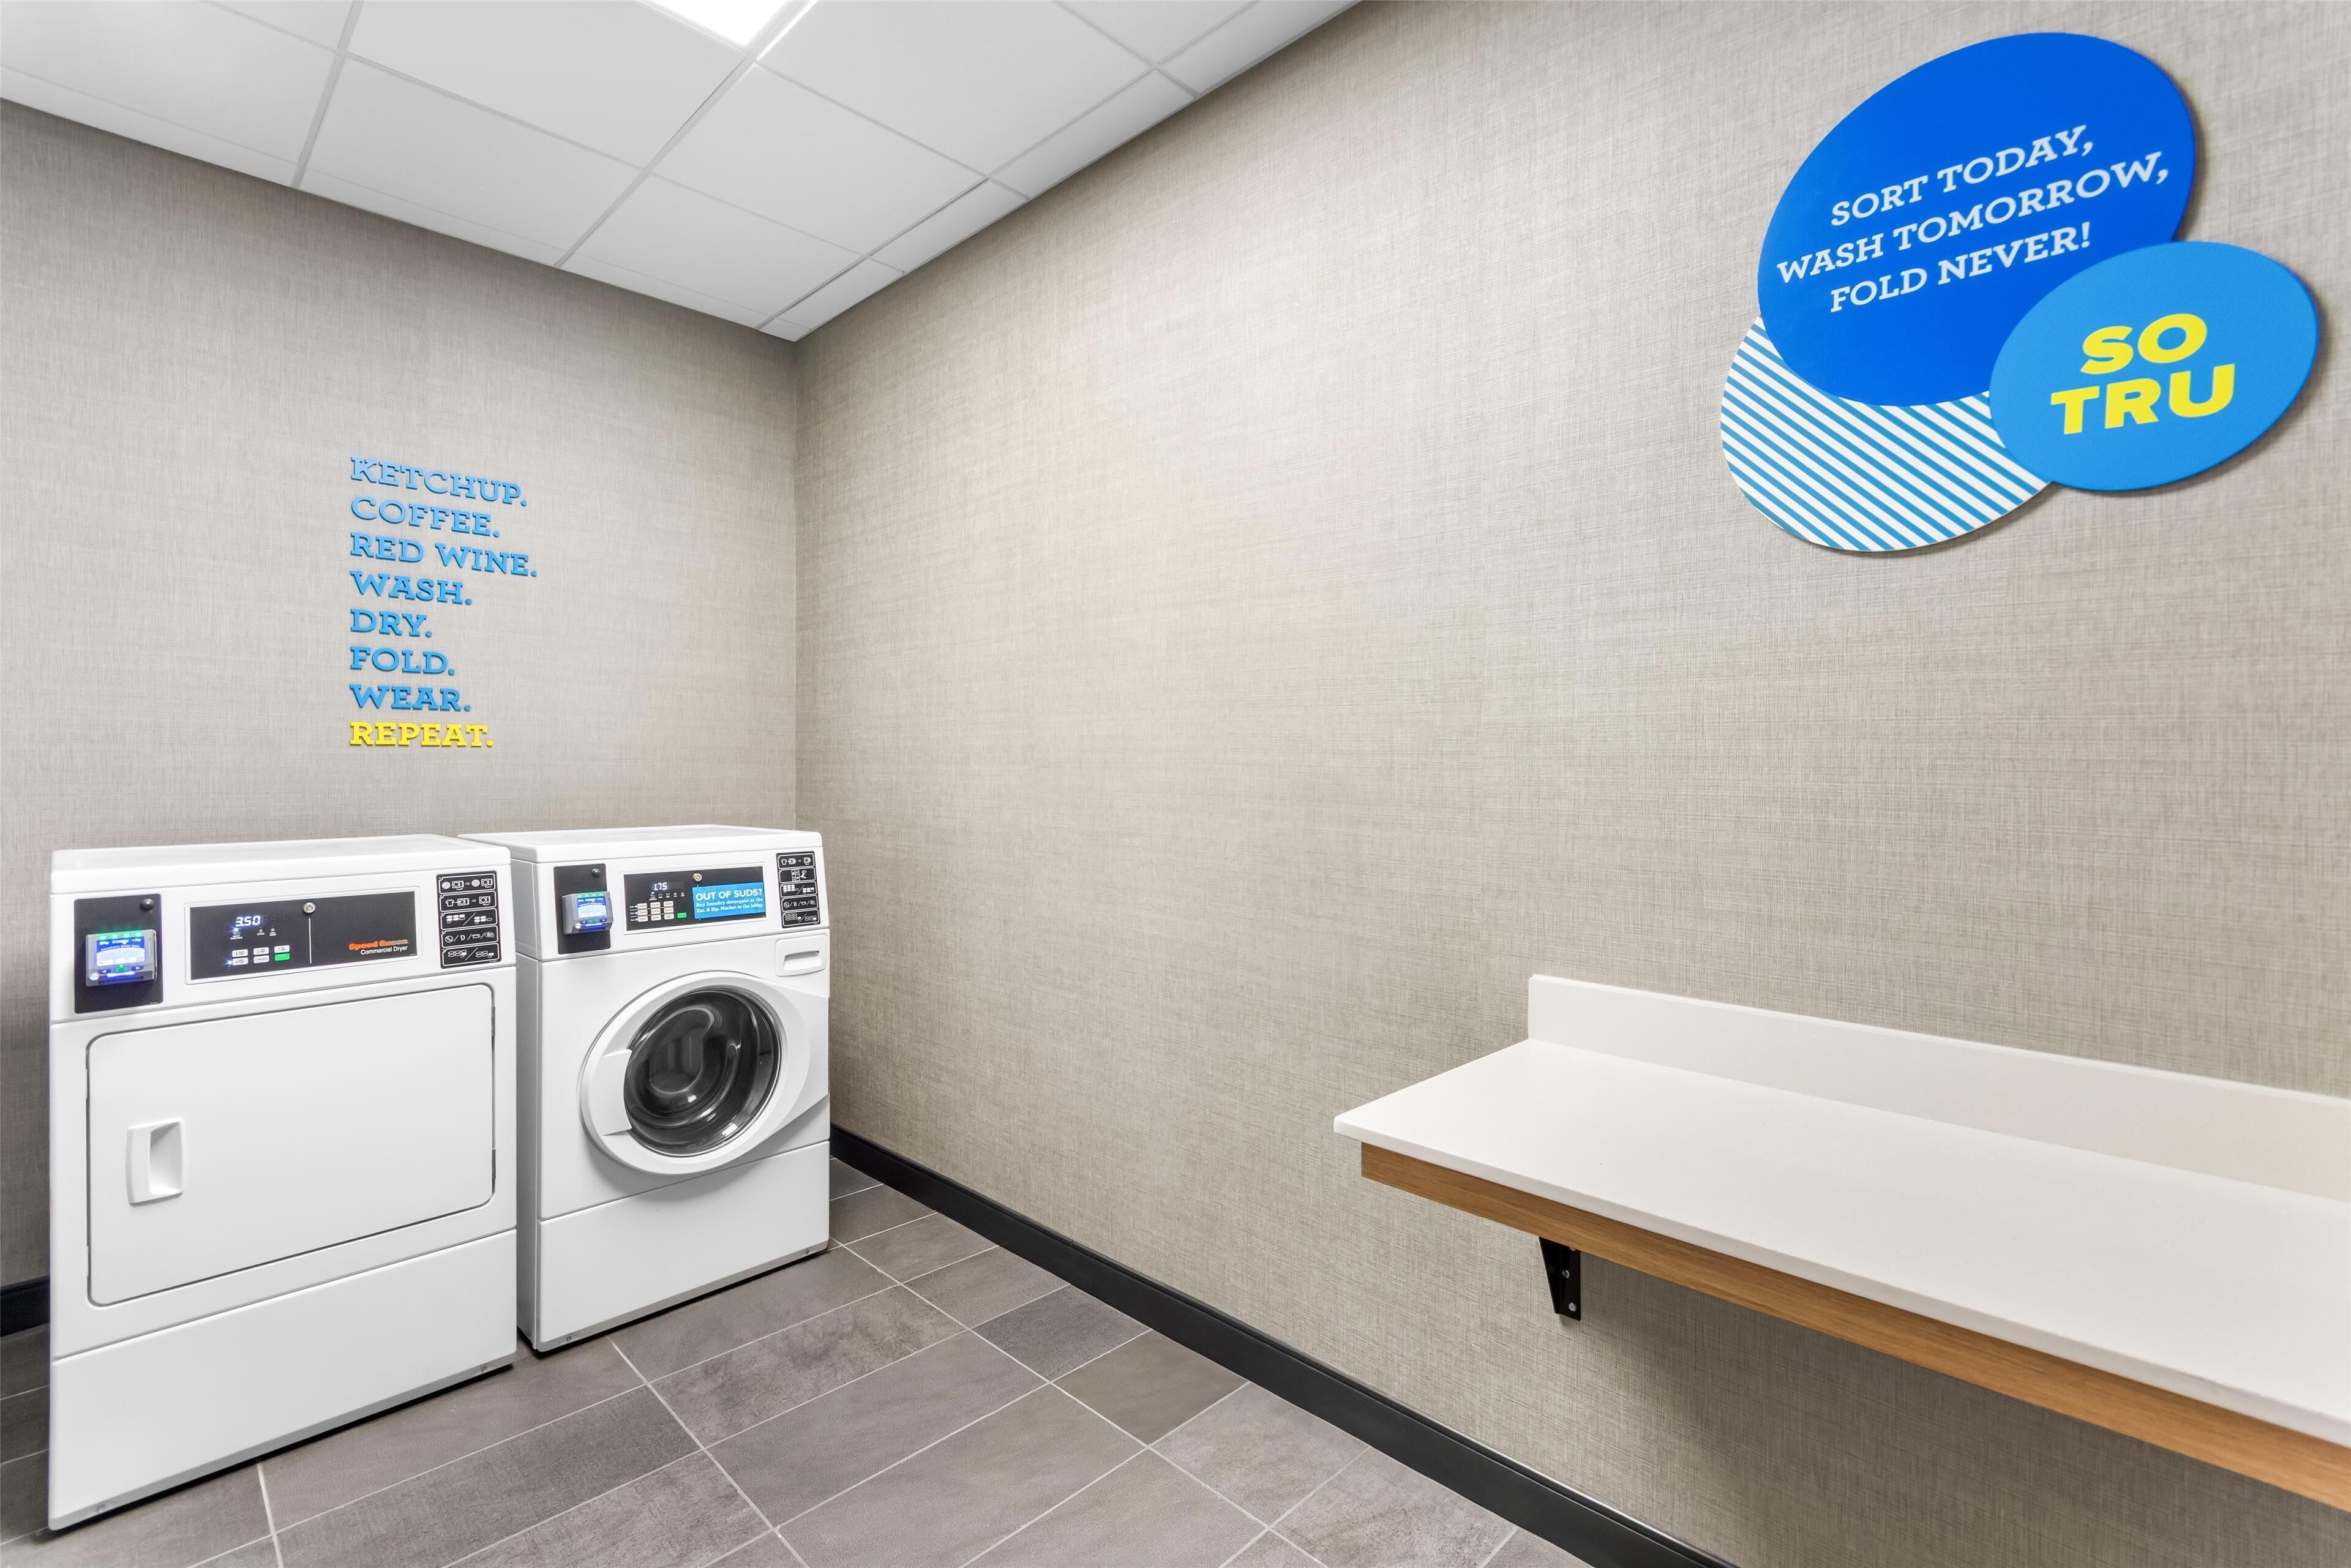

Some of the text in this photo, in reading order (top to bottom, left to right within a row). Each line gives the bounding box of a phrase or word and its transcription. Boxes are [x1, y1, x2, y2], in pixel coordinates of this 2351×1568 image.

[1830, 124, 2093, 227] SORT TODAY,
[1777, 151, 2169, 284] WASH TOMORROW,
[1830, 222, 2091, 313] FOLD NEVER!
[2081, 313, 2207, 375] SO
[2051, 363, 2235, 435] TRU
[351, 456, 527, 507] KETCHUP.
[351, 495, 500, 538] COFFEE.
[350, 531, 538, 577] RED WINE.
[350, 570, 473, 606] WASH.
[350, 608, 432, 637] DRY.
[350, 645, 456, 676] FOLD.
[349, 683, 471, 712] WEAR.
[350, 721, 494, 748] REPEAT.
[695, 888, 763, 901] OUT OF SUDS?
[348, 940, 378, 951] Speed
[360, 947, 392, 955] Commercial
